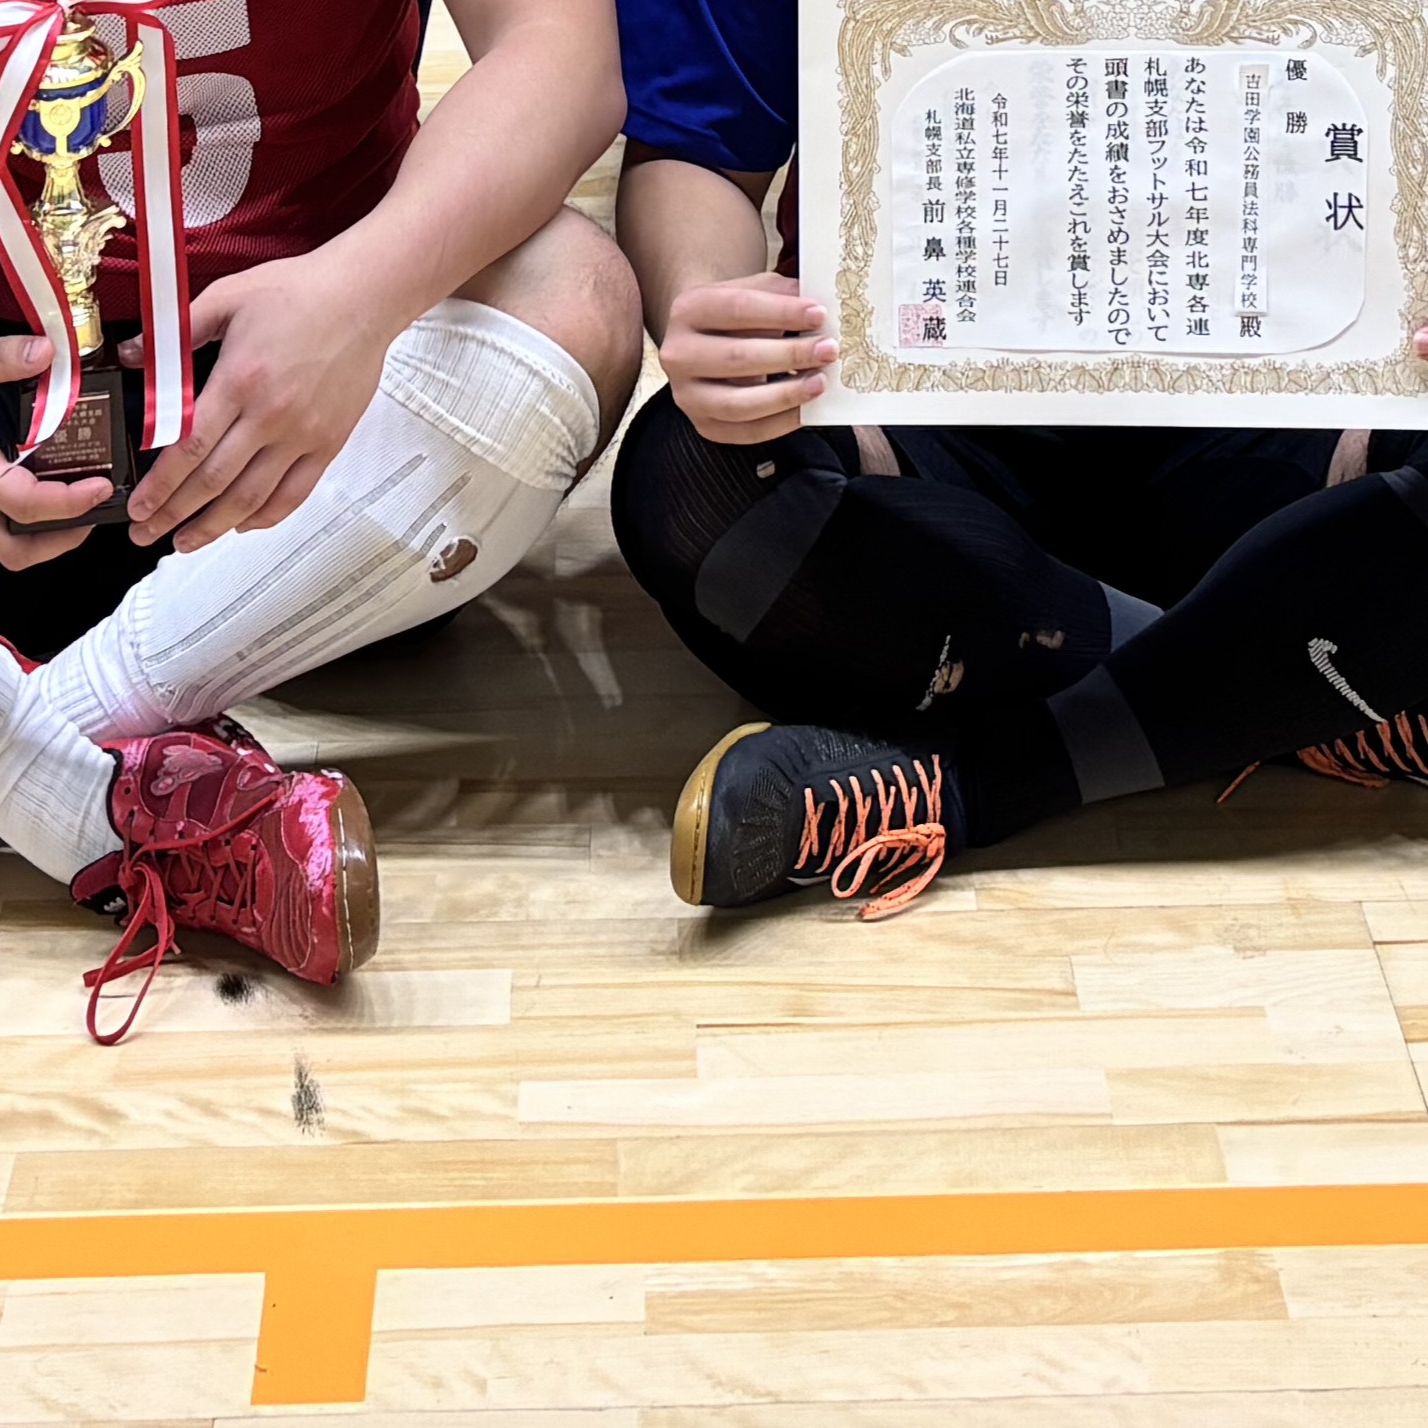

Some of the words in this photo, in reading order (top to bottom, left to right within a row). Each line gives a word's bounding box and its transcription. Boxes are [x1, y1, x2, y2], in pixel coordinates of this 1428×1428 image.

[954, 87, 977, 323] 北海道私立専修学校各種学校連合会
[991, 93, 1010, 287] 令和七年十一月二十七日
[1066, 57, 1092, 327] その栄誉をたたえこれを賞します
[1104, 57, 1131, 346] 頭書の成績をおさめましたので
[1144, 57, 1171, 343] 札幌支部フットサル大会において
[1184, 57, 1211, 337] あなたは令和七年度北専各連
[1285, 58, 1309, 135] 優勝
[1324, 122, 1365, 232] 賞状
